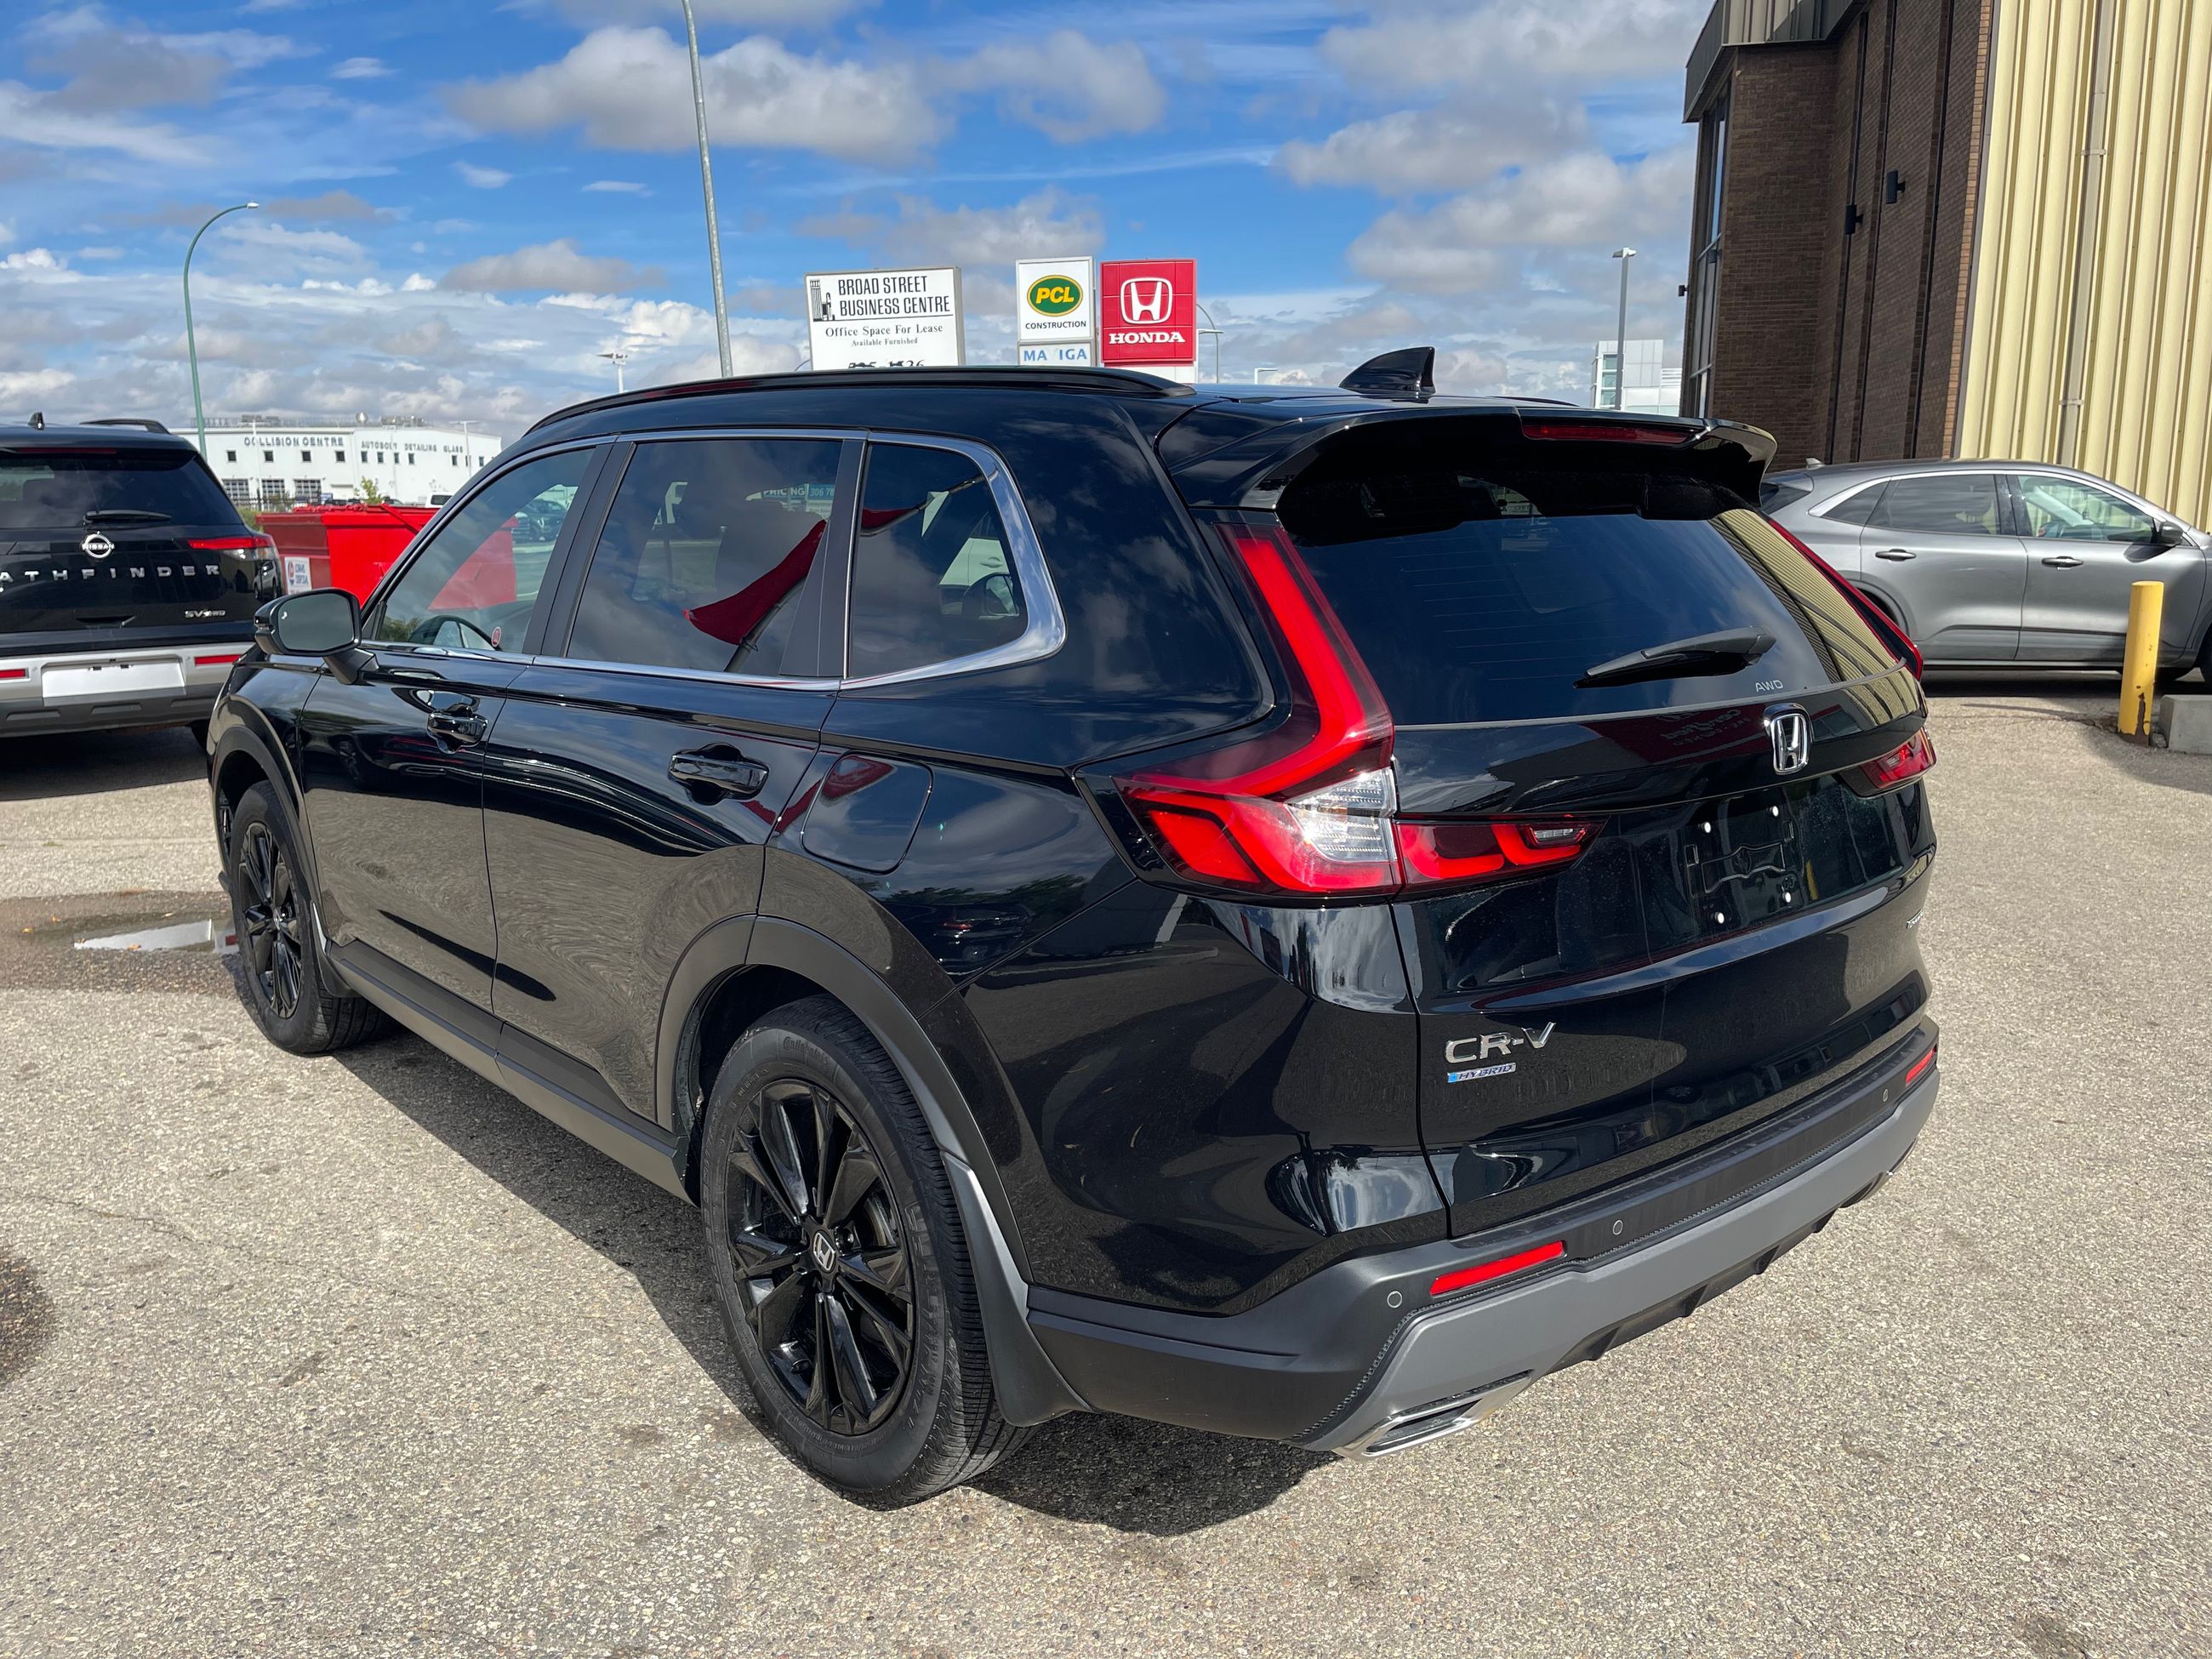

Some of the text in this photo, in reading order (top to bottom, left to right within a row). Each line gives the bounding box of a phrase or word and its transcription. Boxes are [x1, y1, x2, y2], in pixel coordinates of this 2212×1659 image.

[838, 276, 927, 295] BROAD STREET
[1035, 286, 1075, 304] PCL
[840, 295, 950, 316] BUSINESS CENTRE
[825, 323, 944, 337] Office Space For Lease
[1025, 321, 1086, 329] CONSTRUCTION
[884, 337, 918, 345] Furnished
[1109, 332, 1186, 345] HONDA
[1023, 348, 1087, 362] MAIGA
[1755, 680, 1784, 693] AWD
[1445, 1022, 1557, 1063] CR-V
[1458, 1065, 1513, 1080] HYBRID
